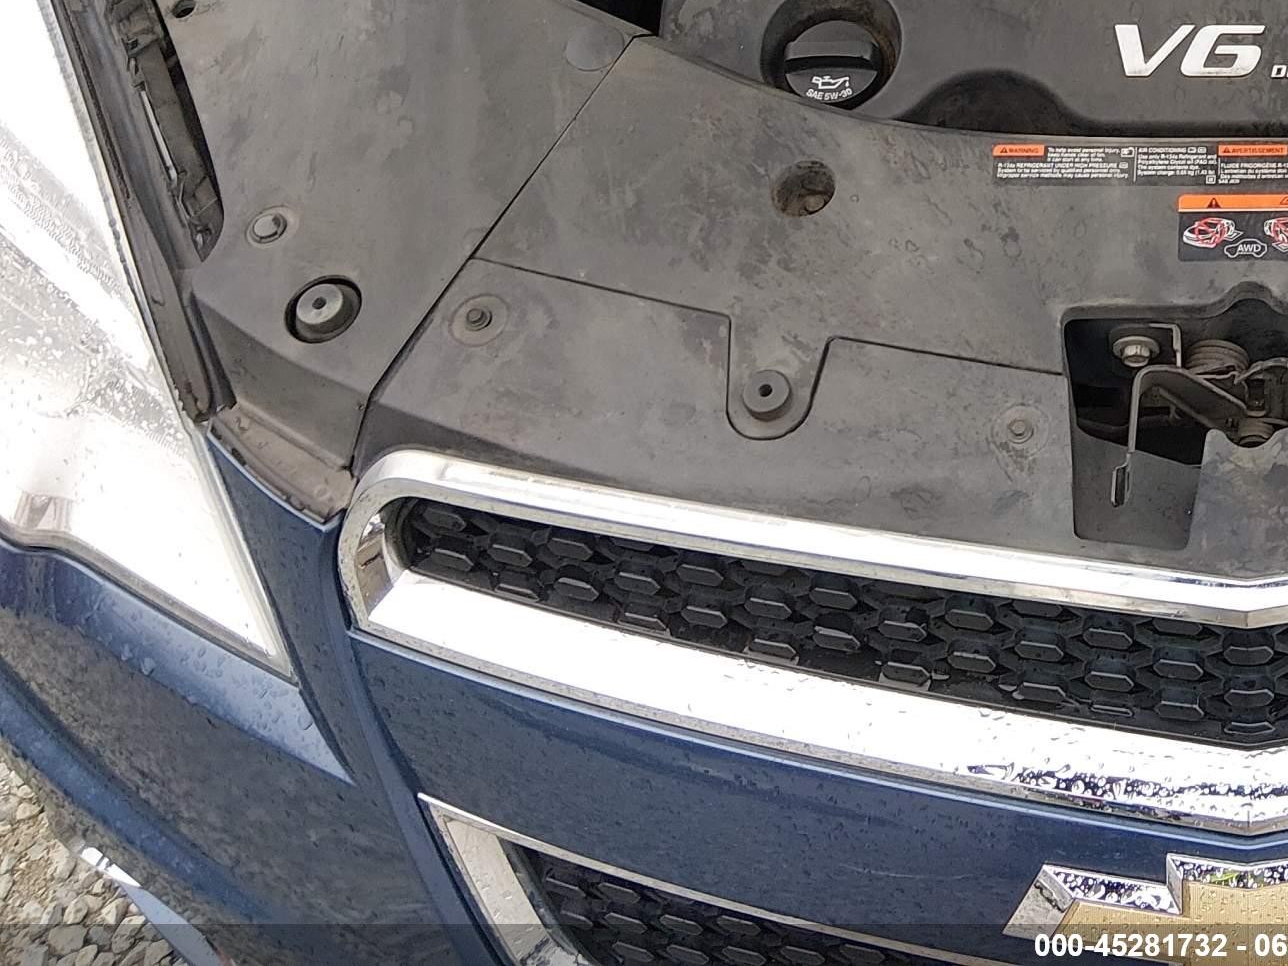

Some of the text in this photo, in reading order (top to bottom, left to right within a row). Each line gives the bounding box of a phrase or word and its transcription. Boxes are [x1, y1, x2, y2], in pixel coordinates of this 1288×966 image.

[1115, 25, 1265, 76] V6
[806, 89, 852, 100] SAE 5W-30
[1237, 244, 1261, 252] AWD
